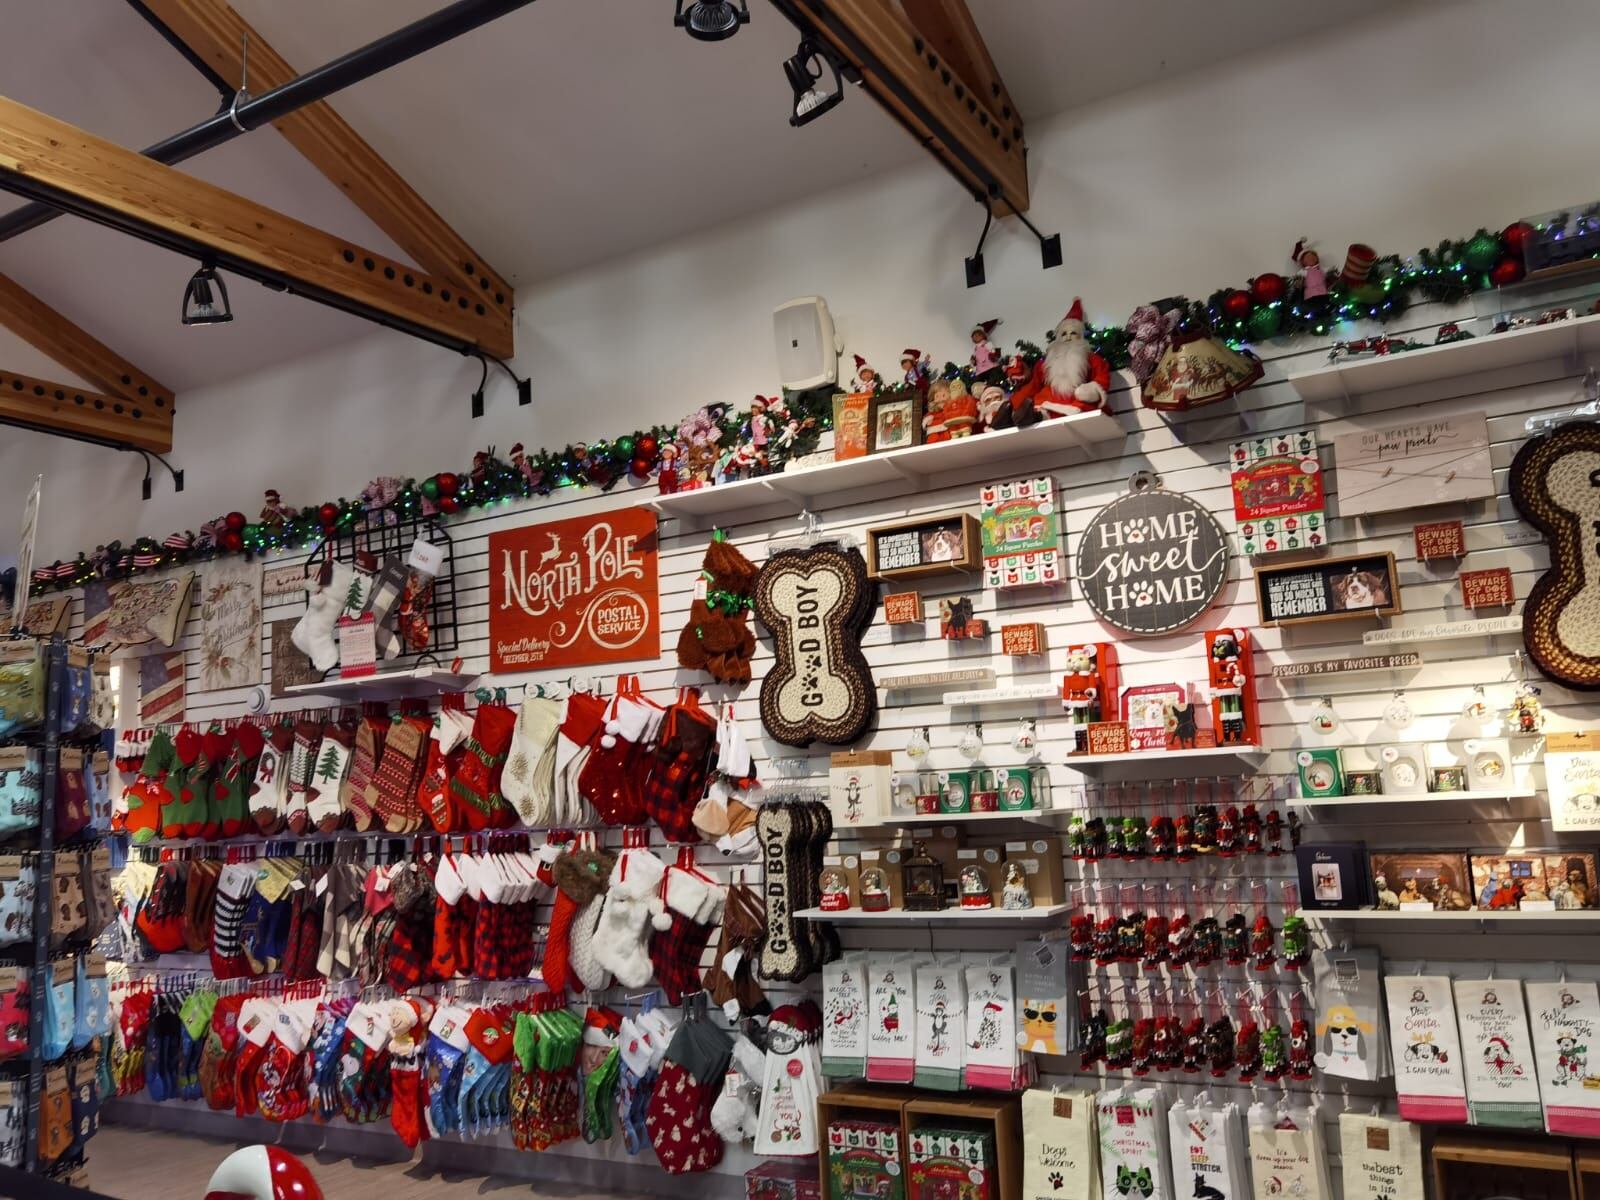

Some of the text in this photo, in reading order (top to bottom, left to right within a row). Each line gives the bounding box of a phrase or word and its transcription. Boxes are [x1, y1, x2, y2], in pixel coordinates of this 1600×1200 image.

[1361, 434, 1381, 446] OUR
[1385, 427, 1421, 442] HEARTS
[1418, 528, 1459, 541] BEWARE
[1421, 538, 1434, 547] OF
[1085, 530, 1218, 582] sweet
[1422, 544, 1459, 555] KISSES
[582, 522, 643, 593] POLE
[879, 552, 920, 570] REMEMBER
[501, 549, 582, 616] NORTH
[1465, 576, 1508, 588] BEWARE
[1270, 587, 1325, 602] YOU SO MUCH TO
[1468, 586, 1482, 595] OF
[1469, 591, 1508, 603] KISSES
[796, 585, 819, 629] BOY
[887, 599, 914, 609] BEWARE
[1271, 596, 1327, 617] REMEMBER
[597, 605, 641, 623] POSTAL
[597, 620, 641, 635] SERVICE
[1004, 629, 1034, 639] BEWARE
[497, 636, 550, 659] Special Delivery
[1006, 643, 1034, 652] KISSES
[1273, 654, 1418, 677] RESCUED IS MY FAVORITE BREED
[1090, 728, 1126, 738] BEWARE
[1093, 737, 1104, 745] OF
[1093, 743, 1126, 752] KISSES
[1142, 736, 1167, 748] Christ
[767, 828, 785, 874] BOY
[1112, 1139, 1151, 1148] CHRISTMAS
[1042, 1143, 1067, 1159] Dogs
[1121, 1148, 1142, 1156] SPIRIT
[1038, 1155, 1076, 1168] Welcome
[1362, 1161, 1403, 1175] the best
[1369, 1173, 1394, 1185] things
[1368, 1183, 1397, 1195] in life
